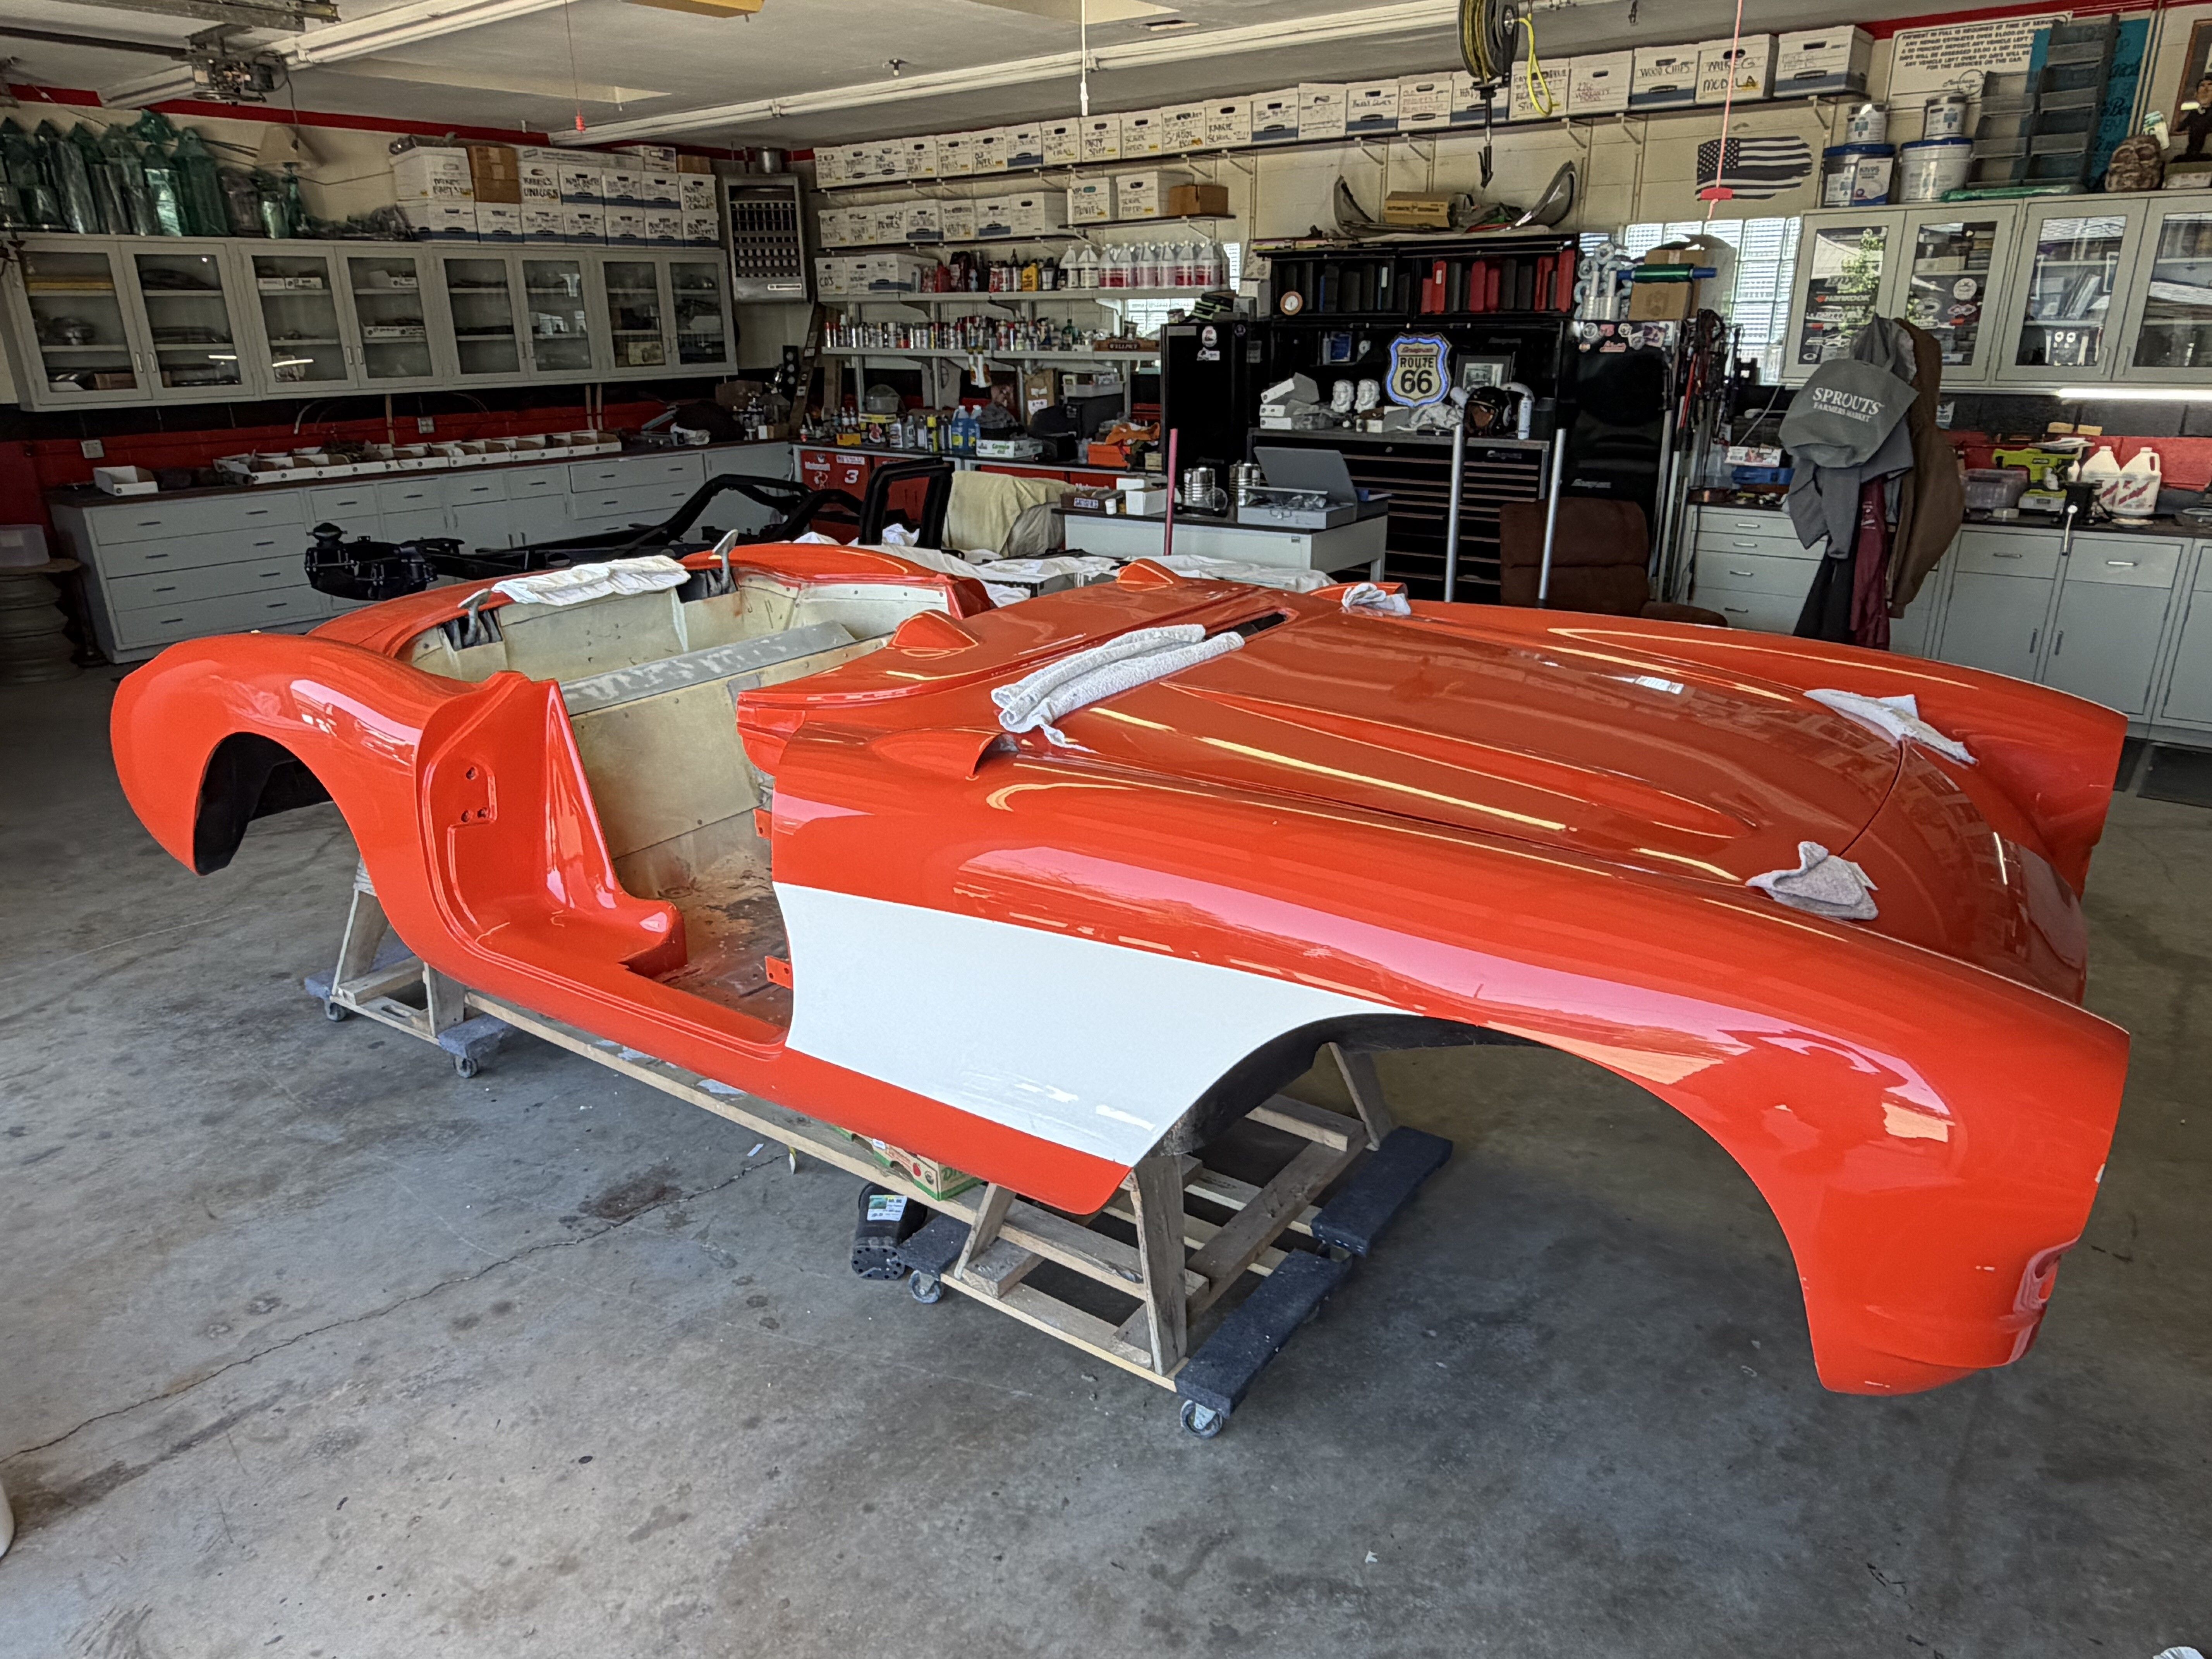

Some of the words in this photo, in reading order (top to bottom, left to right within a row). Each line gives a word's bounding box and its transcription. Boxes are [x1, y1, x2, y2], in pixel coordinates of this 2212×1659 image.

[1400, 357, 1434, 368] ROUTE
[1400, 369, 1432, 394] 66
[1812, 387, 1885, 415] SPROUTS
[1813, 402, 1842, 415] FARMERS
[1845, 409, 1872, 422] MARKET
[844, 469, 859, 484] 3
